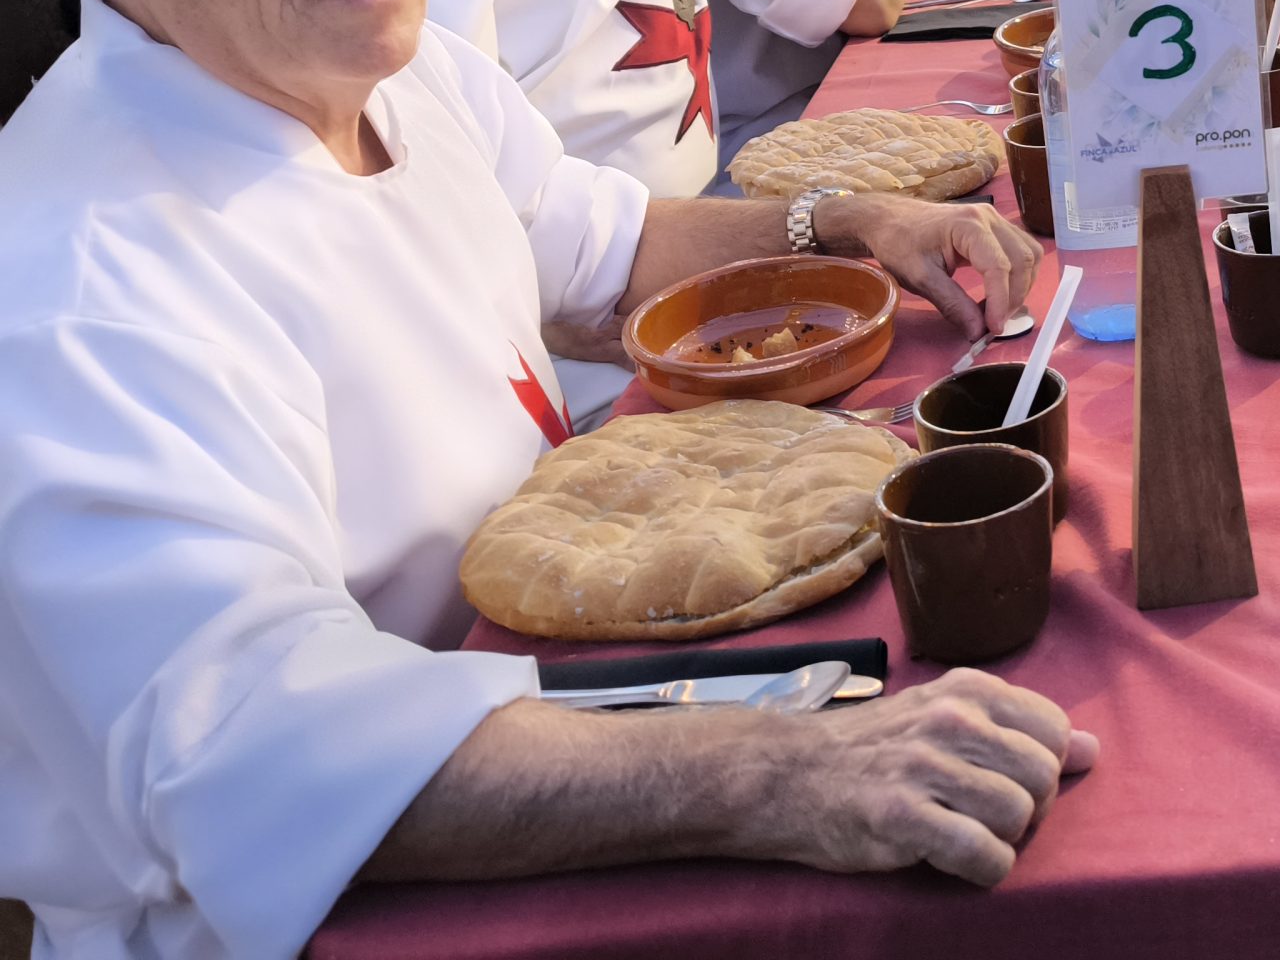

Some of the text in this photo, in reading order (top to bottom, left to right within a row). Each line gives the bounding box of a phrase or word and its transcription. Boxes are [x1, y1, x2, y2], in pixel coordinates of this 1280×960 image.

[1129, 4, 1196, 79] 3
[1195, 128, 1251, 145] pro.pon
[1080, 145, 1137, 157] FINCA AZUL
